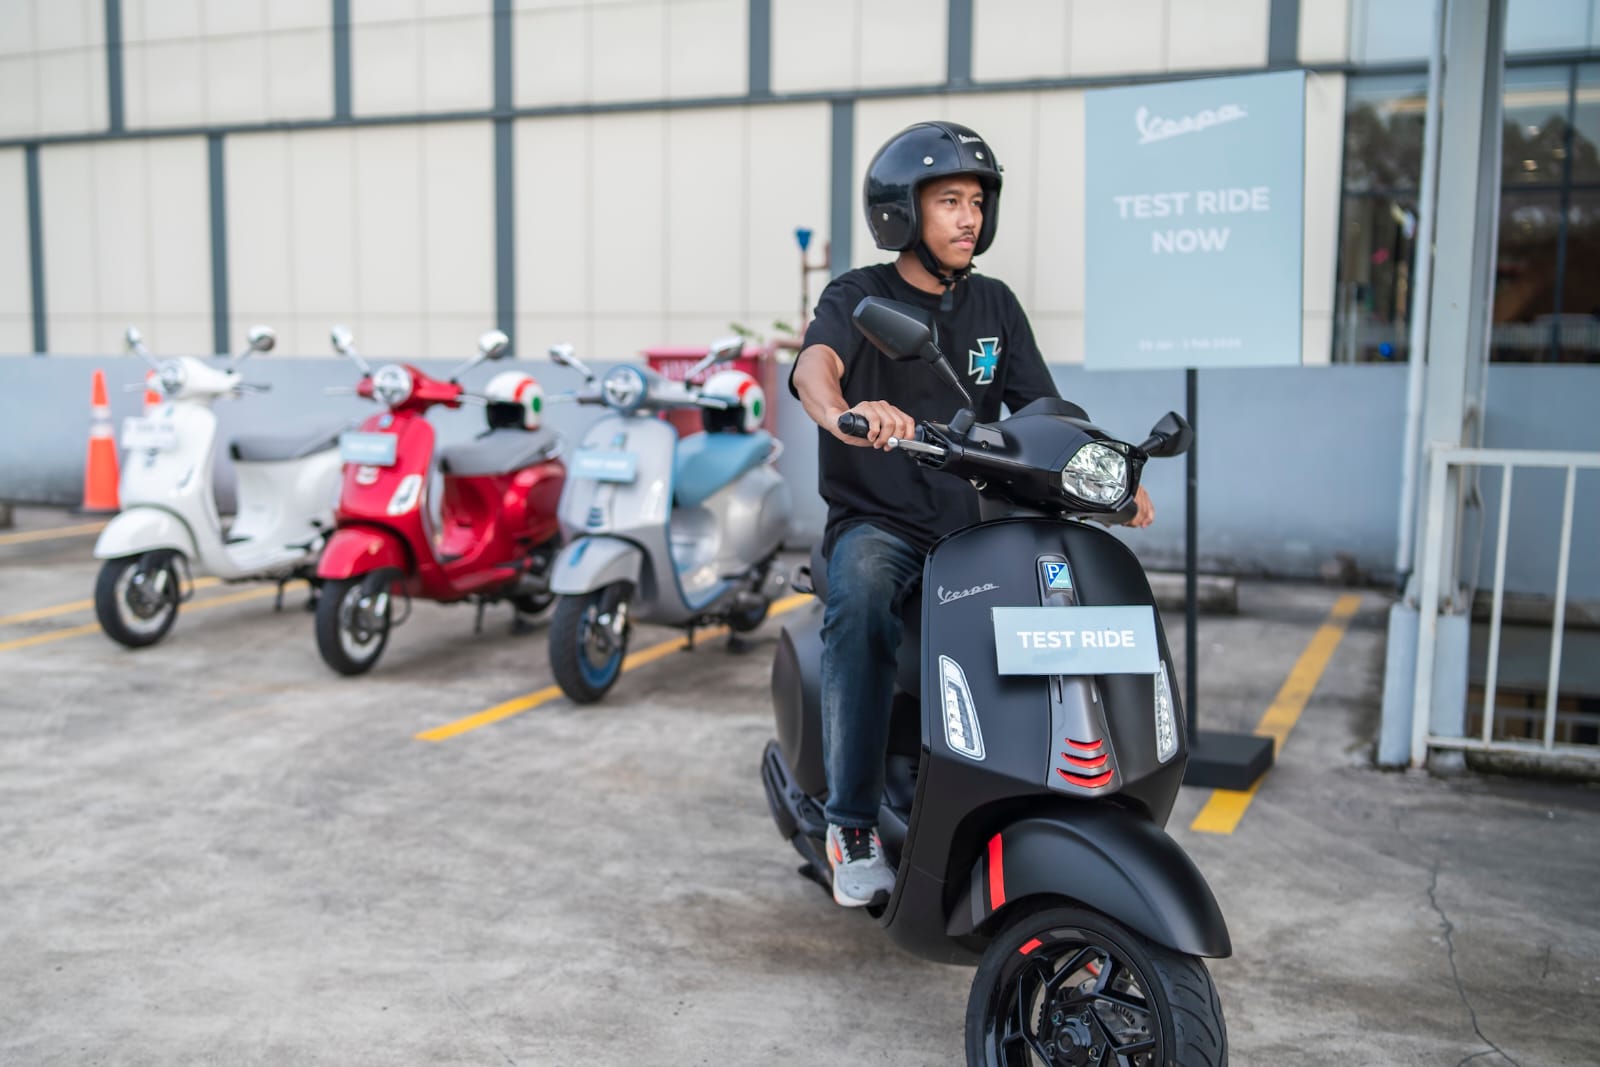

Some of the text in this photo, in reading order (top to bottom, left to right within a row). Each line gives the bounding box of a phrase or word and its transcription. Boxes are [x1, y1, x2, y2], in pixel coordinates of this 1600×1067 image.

[1135, 105, 1248, 144] Vespa
[1113, 187, 1271, 219] TEST RIDE
[1152, 228, 1231, 254] NOW
[937, 583, 1000, 605] Vespa
[1017, 630, 1136, 649] TEST RIDE
